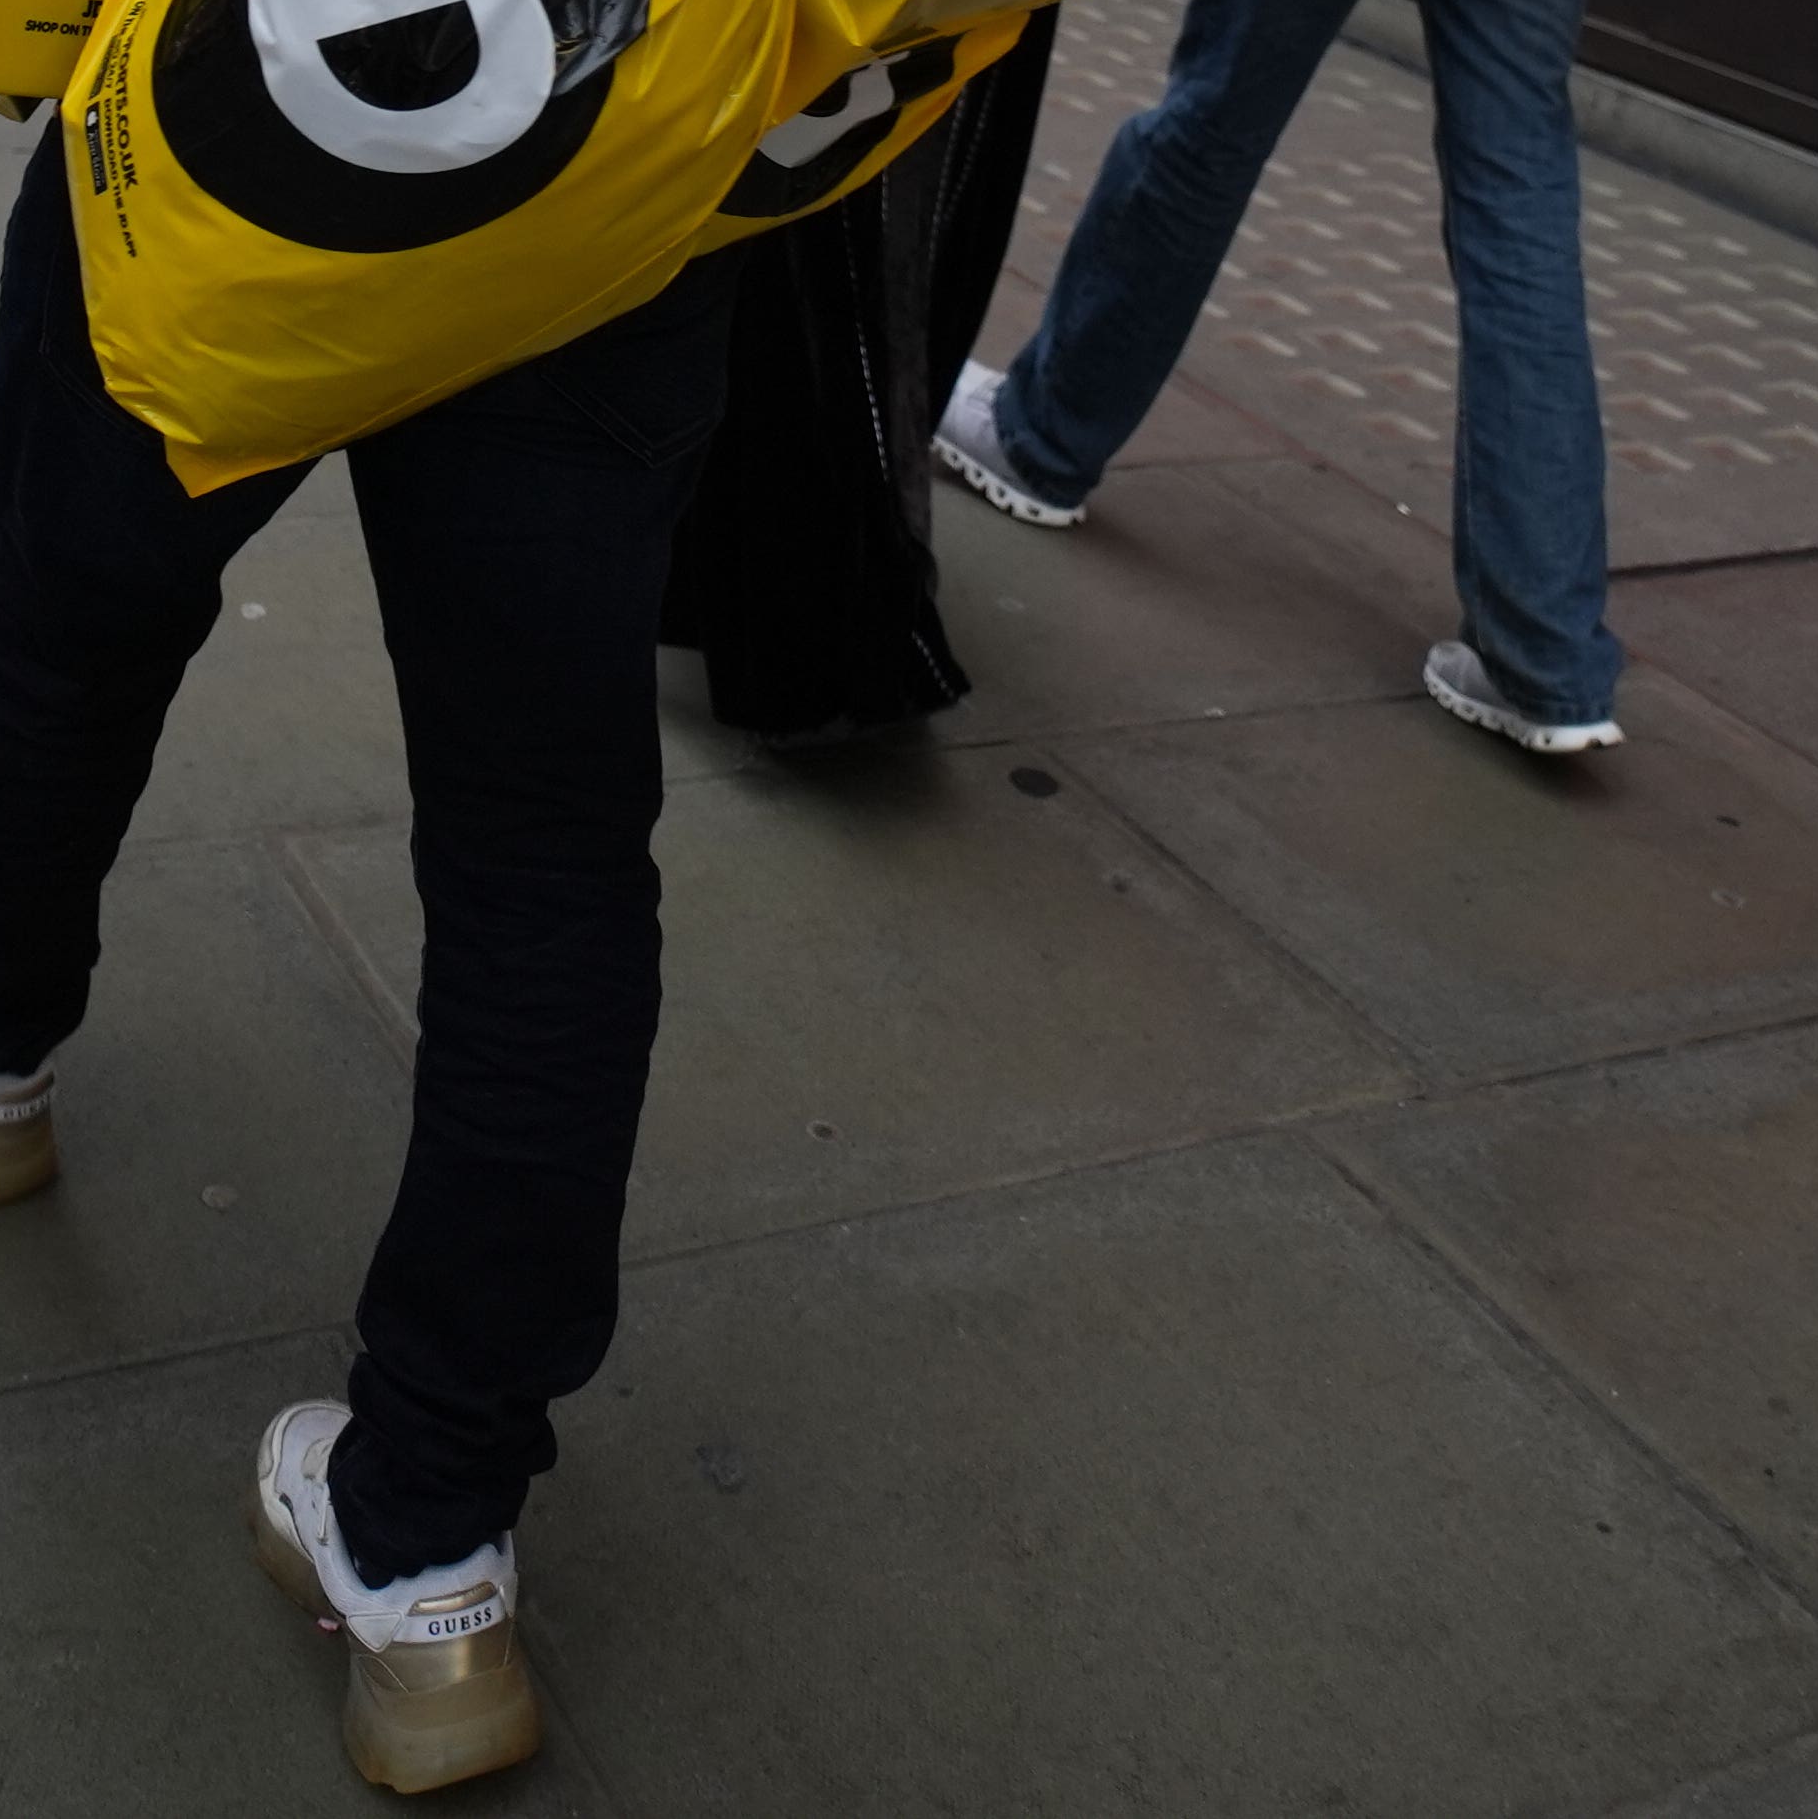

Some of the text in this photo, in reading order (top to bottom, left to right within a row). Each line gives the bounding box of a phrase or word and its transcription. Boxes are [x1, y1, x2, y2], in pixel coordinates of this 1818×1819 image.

[128, 1, 145, 16] ON
[25, 19, 59, 33] SHOP
[60, 23, 80, 35] ON
[123, 232, 137, 258] APP
[428, 1606, 493, 1636] GUESS
